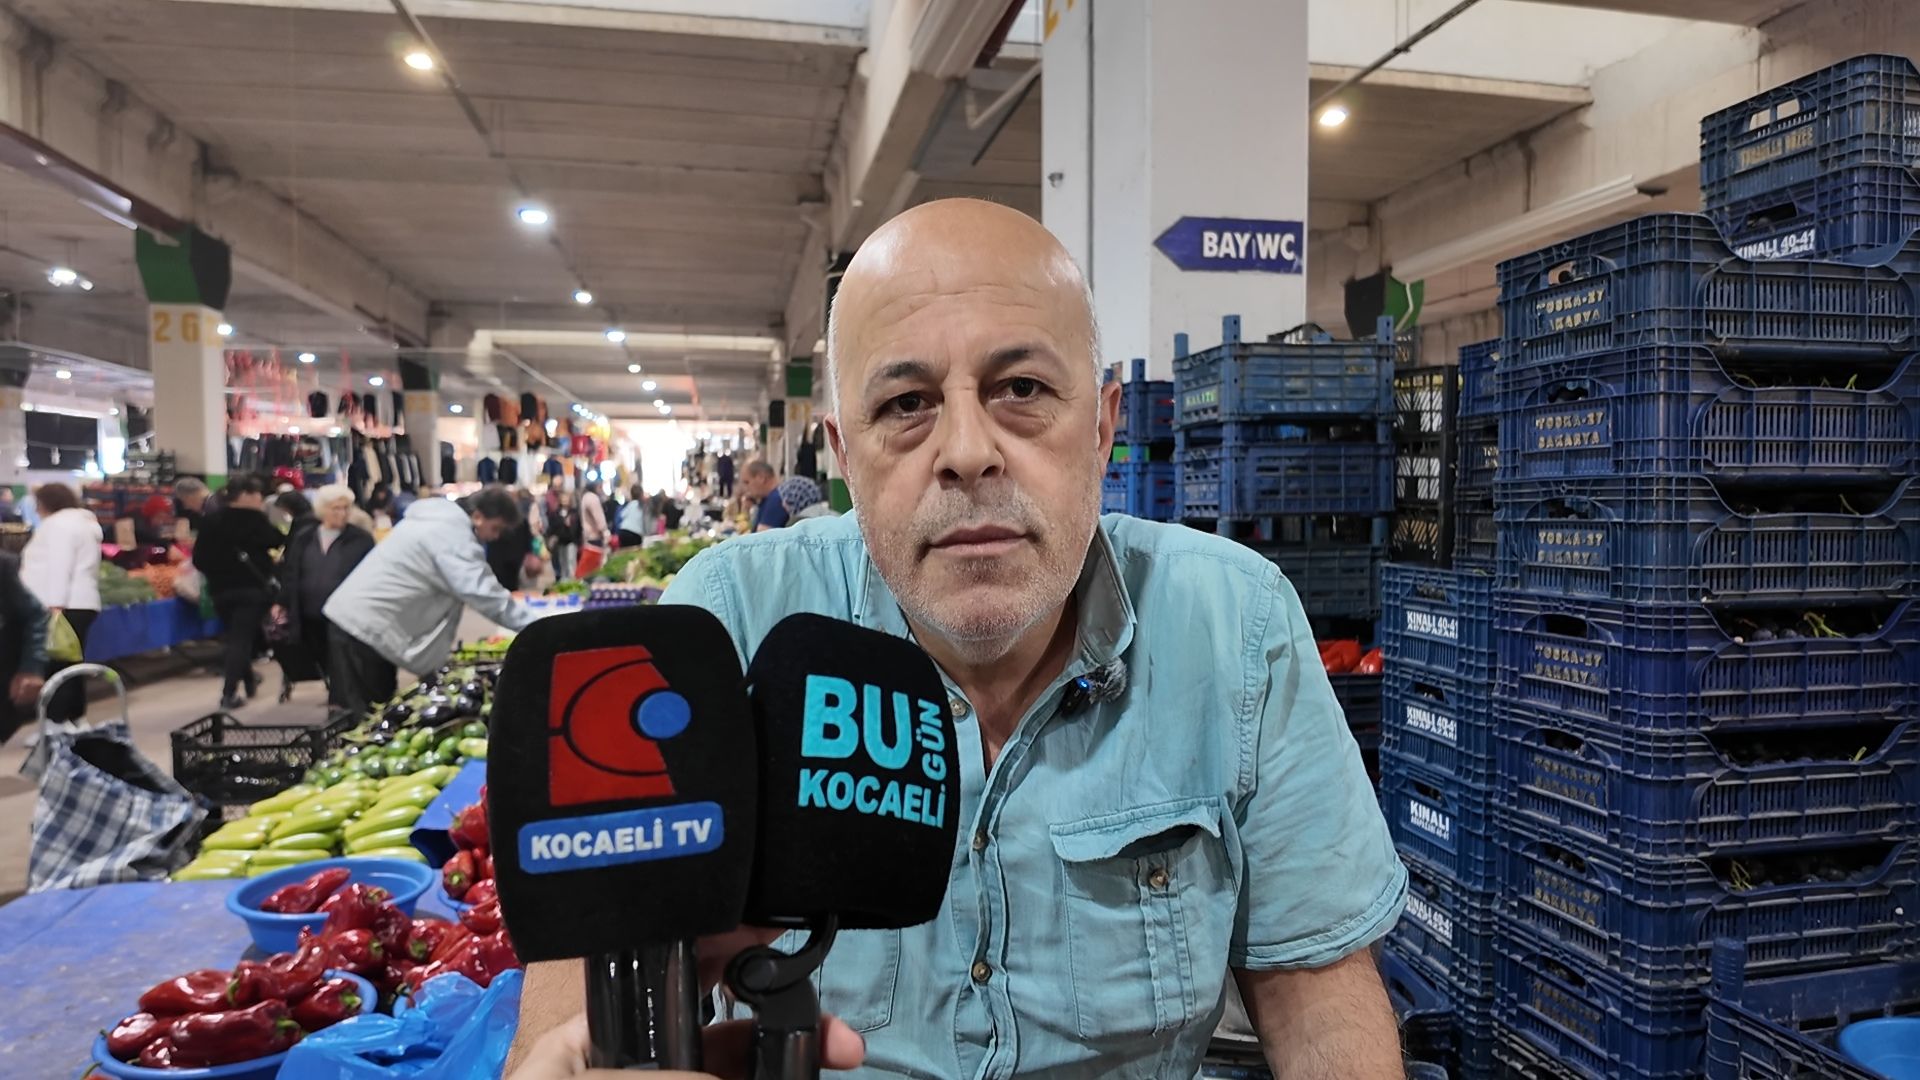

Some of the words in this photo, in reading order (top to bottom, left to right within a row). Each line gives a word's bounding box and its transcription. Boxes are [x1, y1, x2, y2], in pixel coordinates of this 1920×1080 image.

[1203, 231, 1251, 259] BAY
[1256, 233, 1295, 261] WC
[1780, 229, 1815, 250] 40-41
[1538, 431, 1600, 449] SAKARYA
[1407, 610, 1436, 628] KINALI
[1437, 616, 1459, 634] 40-41
[801, 674, 913, 769] BU
[1407, 705, 1436, 727] KINALI
[916, 698, 947, 781] GÜN
[798, 768, 946, 829] KOCAELİ
[1410, 800, 1450, 832] KINALI
[531, 817, 663, 860] KOCAELİ
[672, 818, 712, 846] TV
